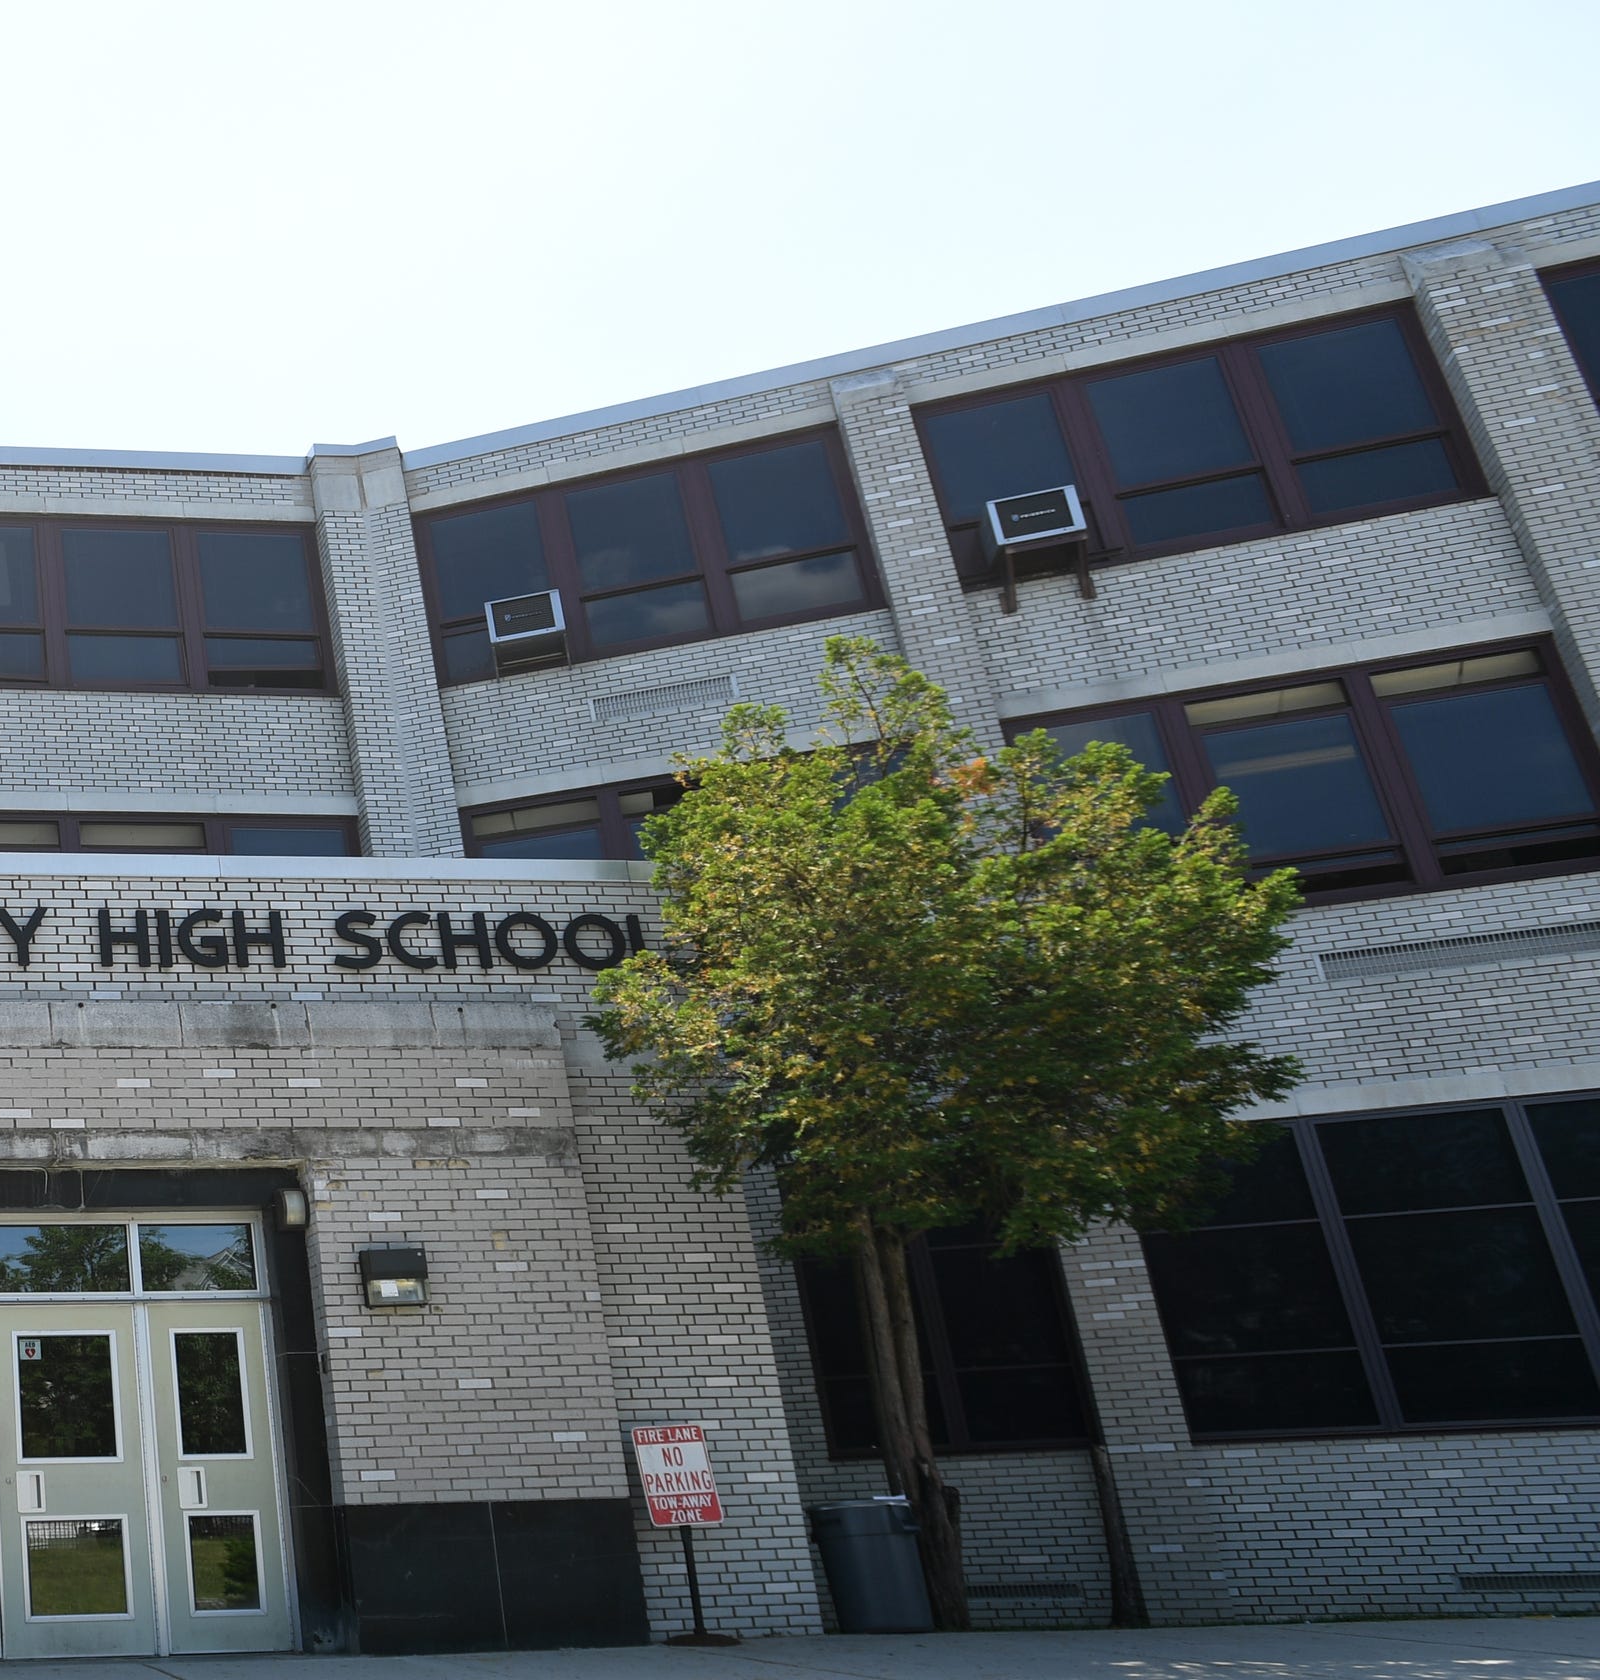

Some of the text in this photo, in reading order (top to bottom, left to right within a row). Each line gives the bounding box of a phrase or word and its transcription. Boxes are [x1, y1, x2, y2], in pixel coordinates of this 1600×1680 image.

[99, 908, 287, 969] HIGH
[637, 1427, 699, 1443] FIRE LANE
[662, 1446, 684, 1467] NO
[644, 1470, 712, 1493] PARKING
[651, 1494, 712, 1511] TOW-AWAY
[670, 1509, 705, 1523] ZONE
